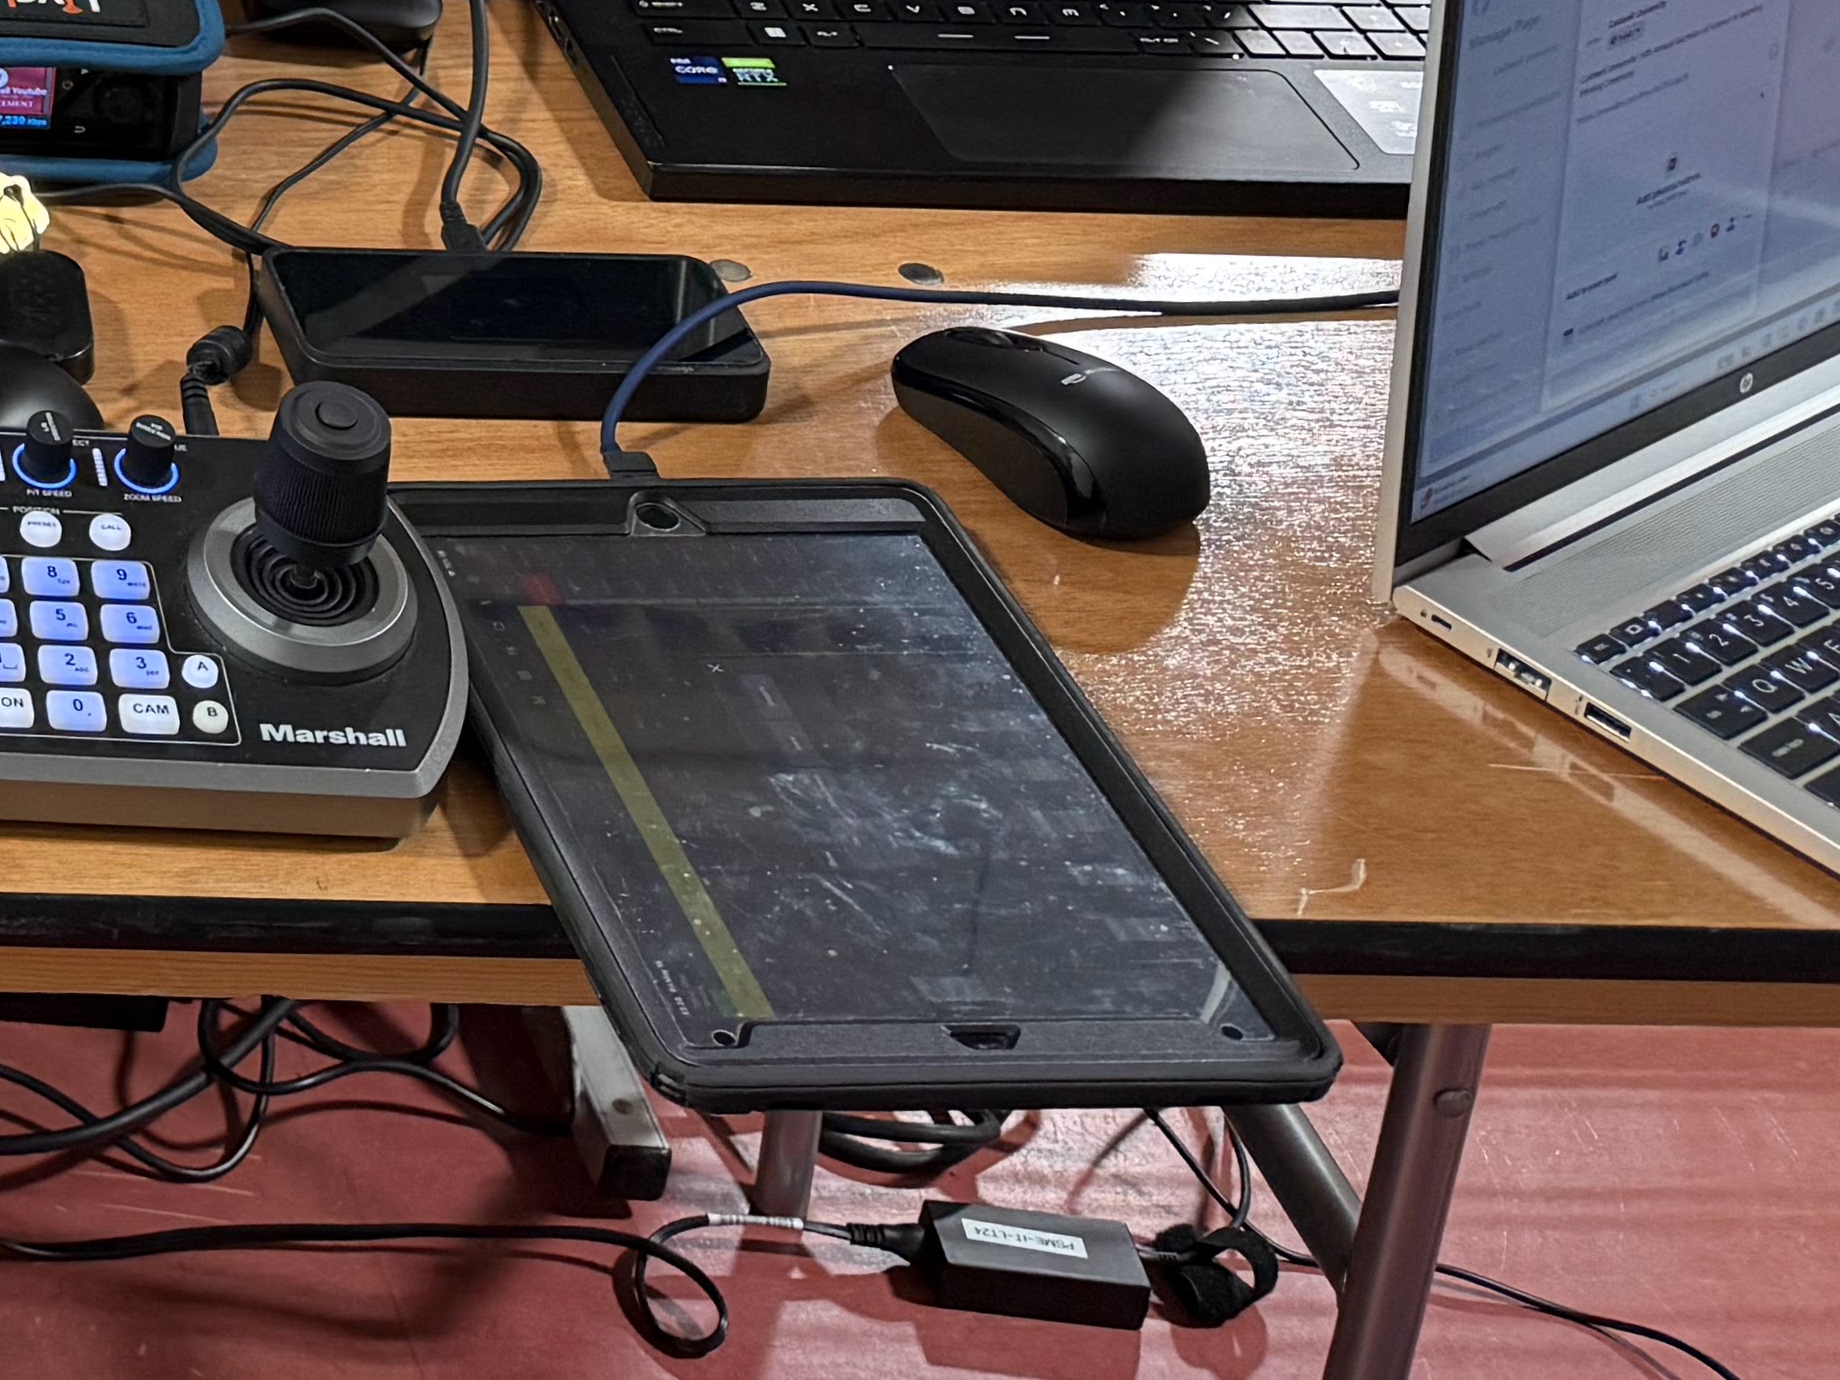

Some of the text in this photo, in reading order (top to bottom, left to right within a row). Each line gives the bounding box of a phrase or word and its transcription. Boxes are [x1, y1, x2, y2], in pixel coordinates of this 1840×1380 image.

[47, 566, 57, 578] 8
[117, 568, 127, 581] 9
[56, 609, 66, 621] 5
[126, 612, 137, 624] 6
[65, 654, 75, 666] 2
[135, 657, 147, 670] 3
[133, 704, 169, 714] CAM
[260, 724, 407, 747] Marshall
